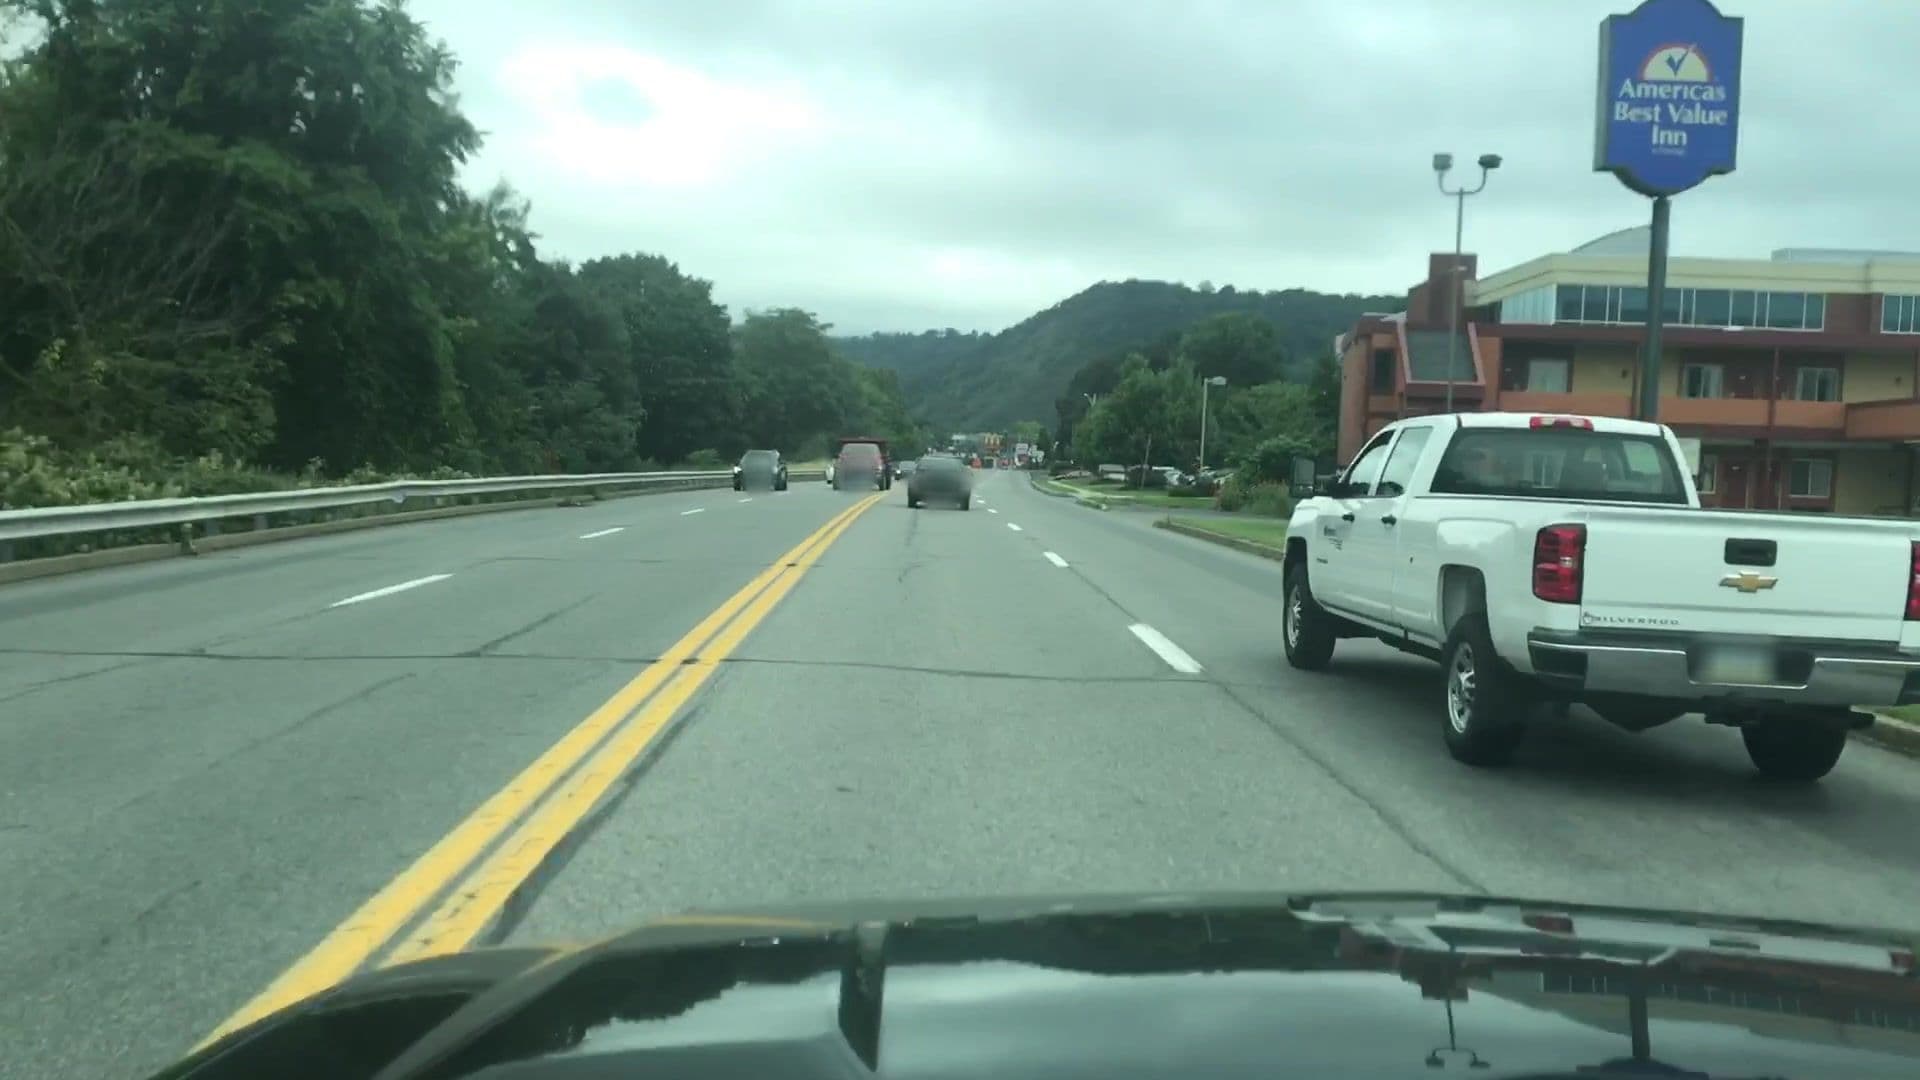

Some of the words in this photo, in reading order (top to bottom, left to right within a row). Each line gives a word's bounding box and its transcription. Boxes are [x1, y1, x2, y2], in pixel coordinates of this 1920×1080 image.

[1619, 78, 1726, 101] Americas
[1614, 101, 1661, 122] Best
[1668, 102, 1728, 125] Value
[1652, 124, 1687, 145] Inn
